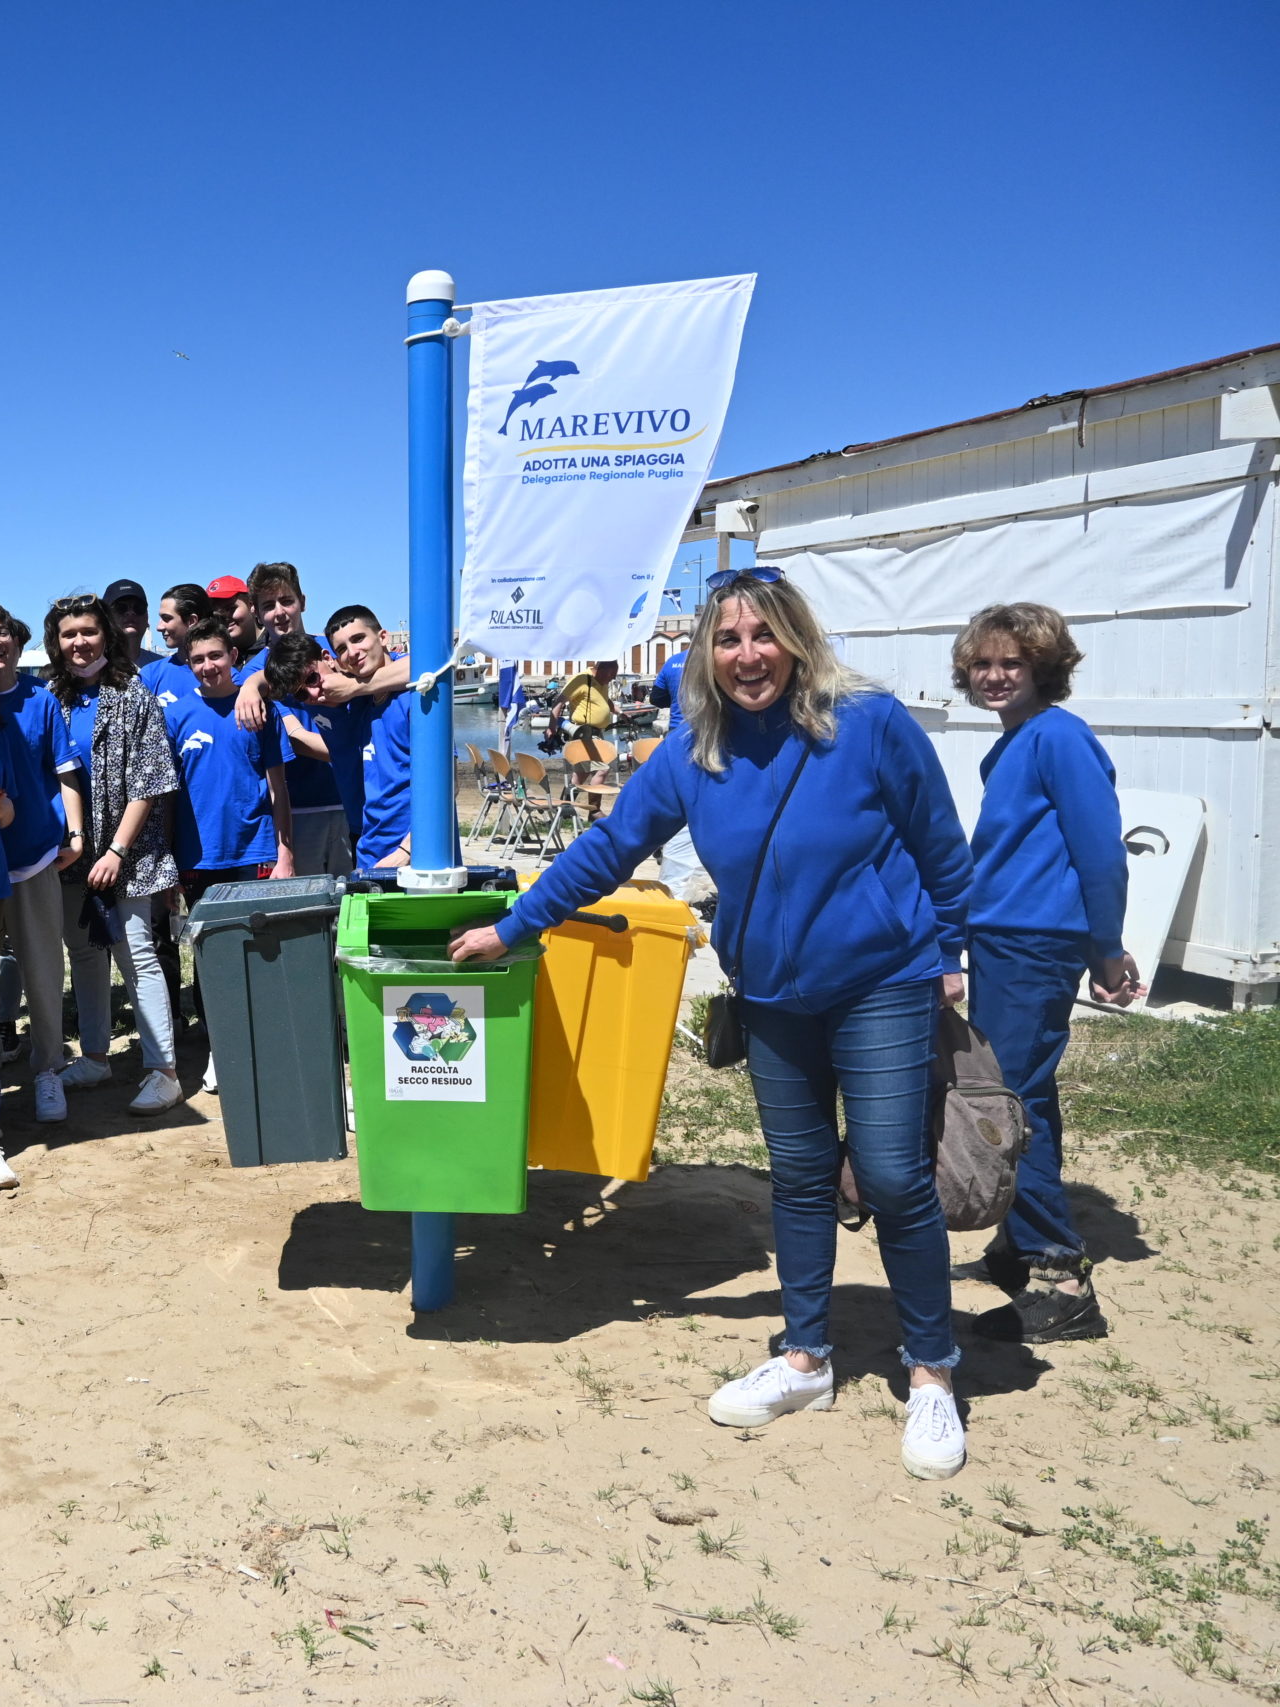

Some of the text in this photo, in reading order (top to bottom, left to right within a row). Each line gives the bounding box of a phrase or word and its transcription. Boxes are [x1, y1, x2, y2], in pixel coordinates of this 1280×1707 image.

[520, 408, 691, 441] MAREVIVO
[523, 453, 685, 472] ADOTTA UNA SPIAGGIA
[521, 468, 684, 484] Delegazione Regionale Puglia
[489, 609, 544, 624] RILASTIL
[411, 1066, 459, 1074] RACCOLTA
[398, 1077, 473, 1085] SECCO RESIDUO
